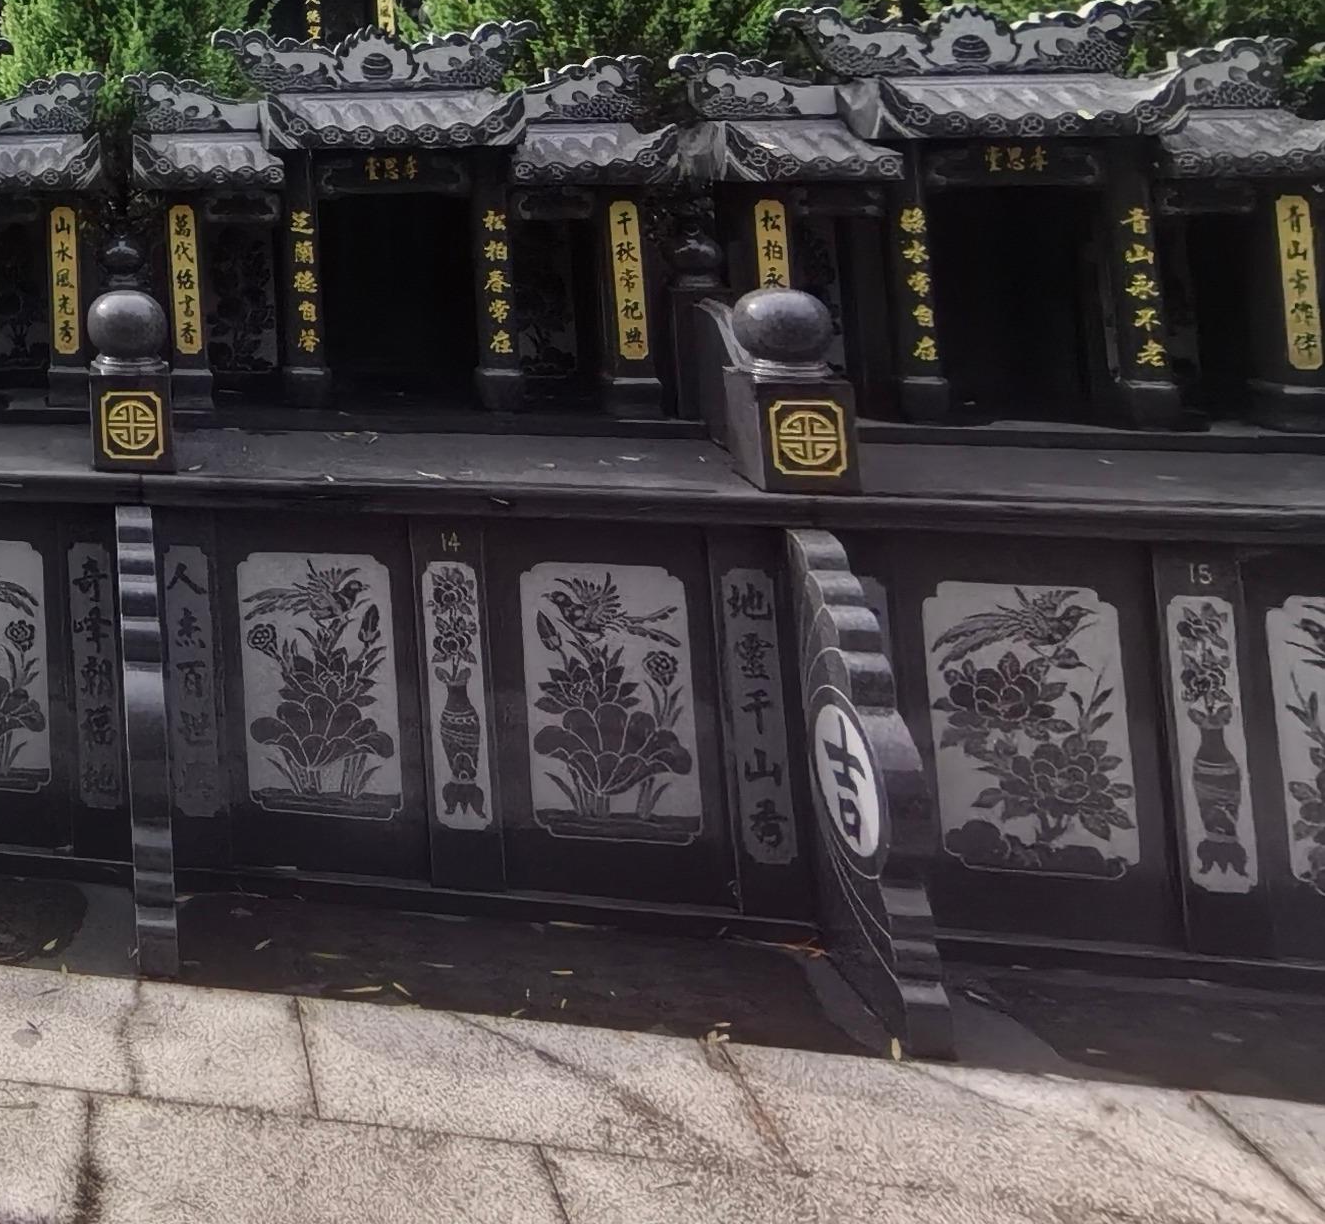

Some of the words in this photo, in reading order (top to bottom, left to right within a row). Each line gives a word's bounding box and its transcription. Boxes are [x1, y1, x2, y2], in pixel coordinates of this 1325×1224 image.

[440, 532, 462, 553] 14
[1188, 562, 1213, 586] 15
[822, 714, 867, 847] 吉
